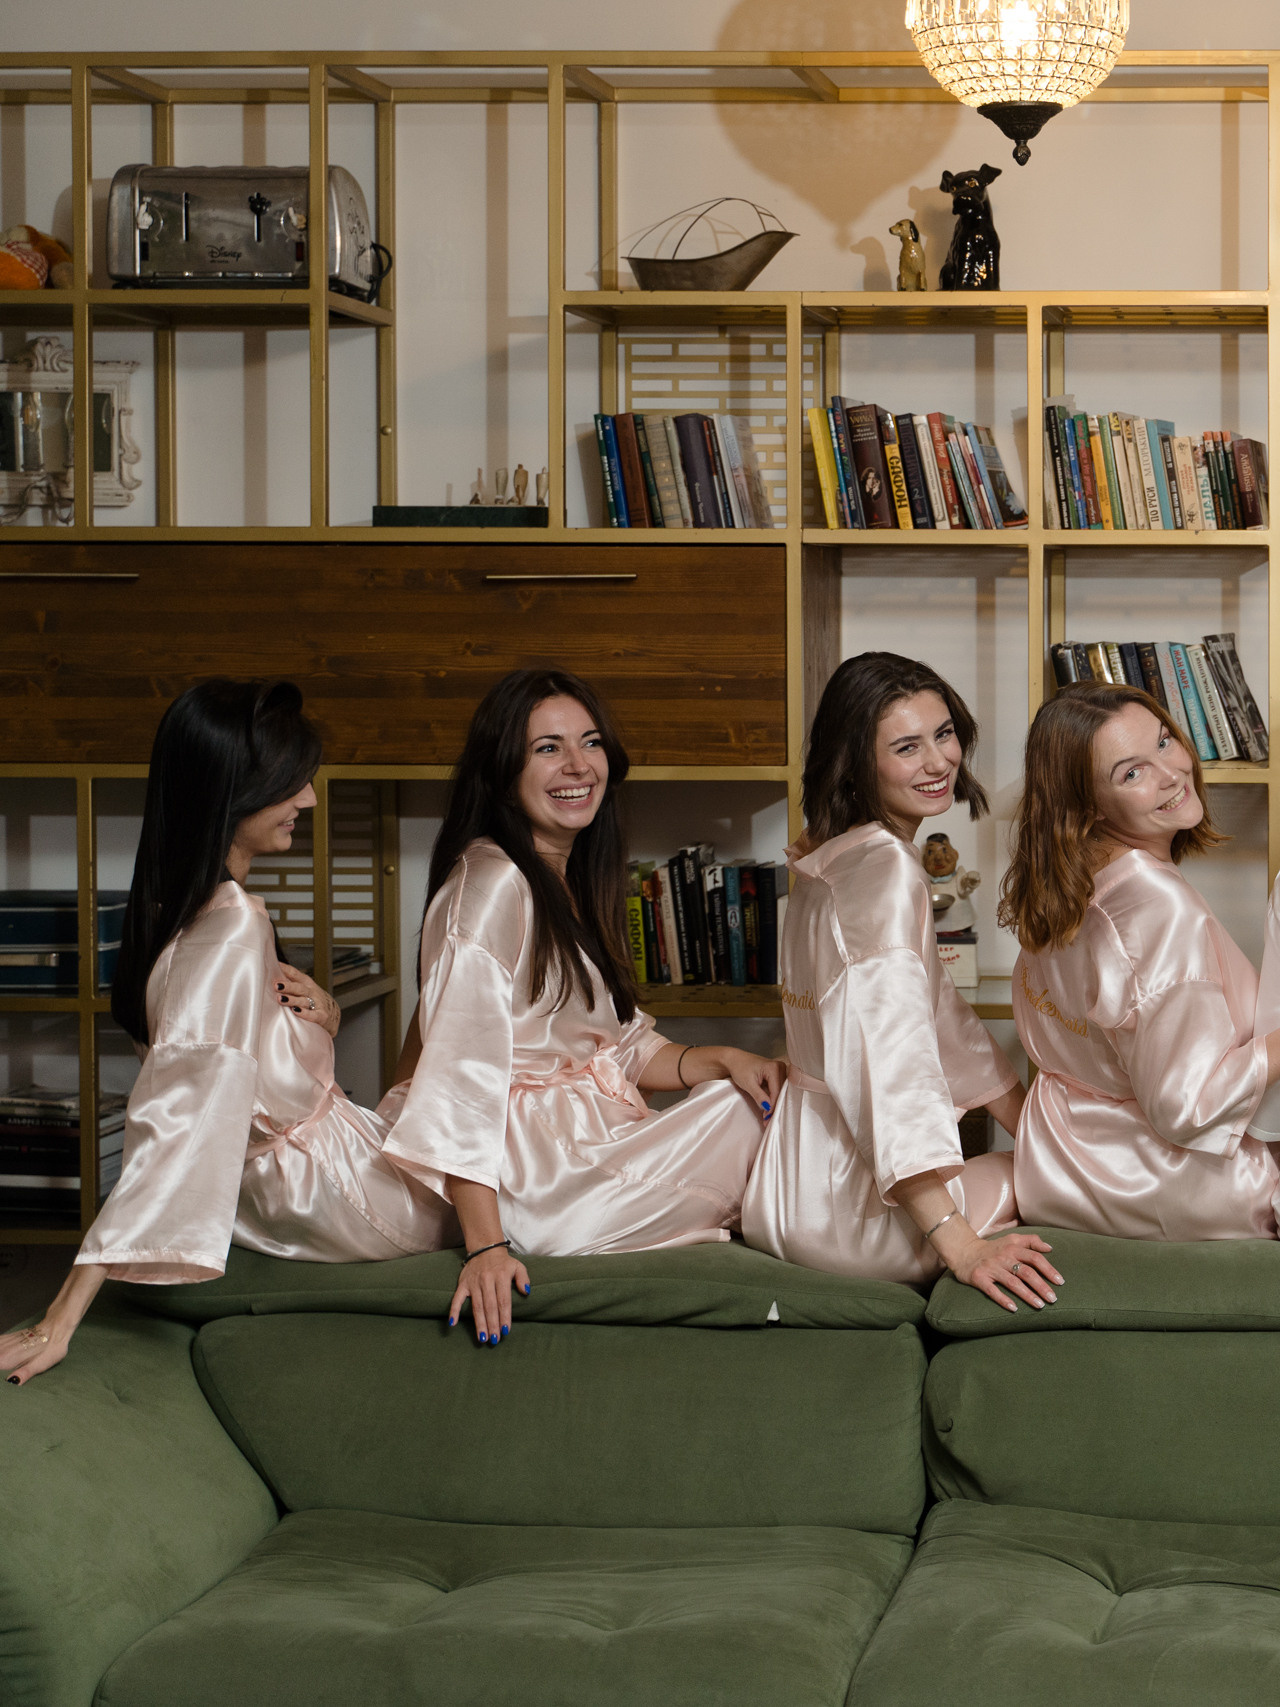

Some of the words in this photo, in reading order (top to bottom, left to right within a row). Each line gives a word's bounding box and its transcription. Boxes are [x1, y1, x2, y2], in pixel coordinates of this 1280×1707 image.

[206, 245, 242, 262] Disney
[888, 455, 908, 508] САФОН
[1239, 452, 1253, 491] Andalusia
[911, 489, 922, 498] 2
[1145, 486, 1157, 508] РУСИ
[1199, 478, 1215, 521] ДАЛЬ
[1149, 509, 1159, 522] ПО
[1108, 652, 1127, 686] БЕРРОУ
[1195, 656, 1210, 693] РОЖДЕНИЯ
[1173, 649, 1183, 667] ЖАН
[1178, 668, 1189, 689] МАРЕ
[1186, 698, 1201, 734] ПАРИЖСКИЕ
[1196, 734, 1209, 757] ТАЙНЫ
[1206, 694, 1216, 712] ДЕНЬ
[1211, 713, 1226, 748] ЗАБЫТЫЙ
[628, 908, 643, 961] САФОН
